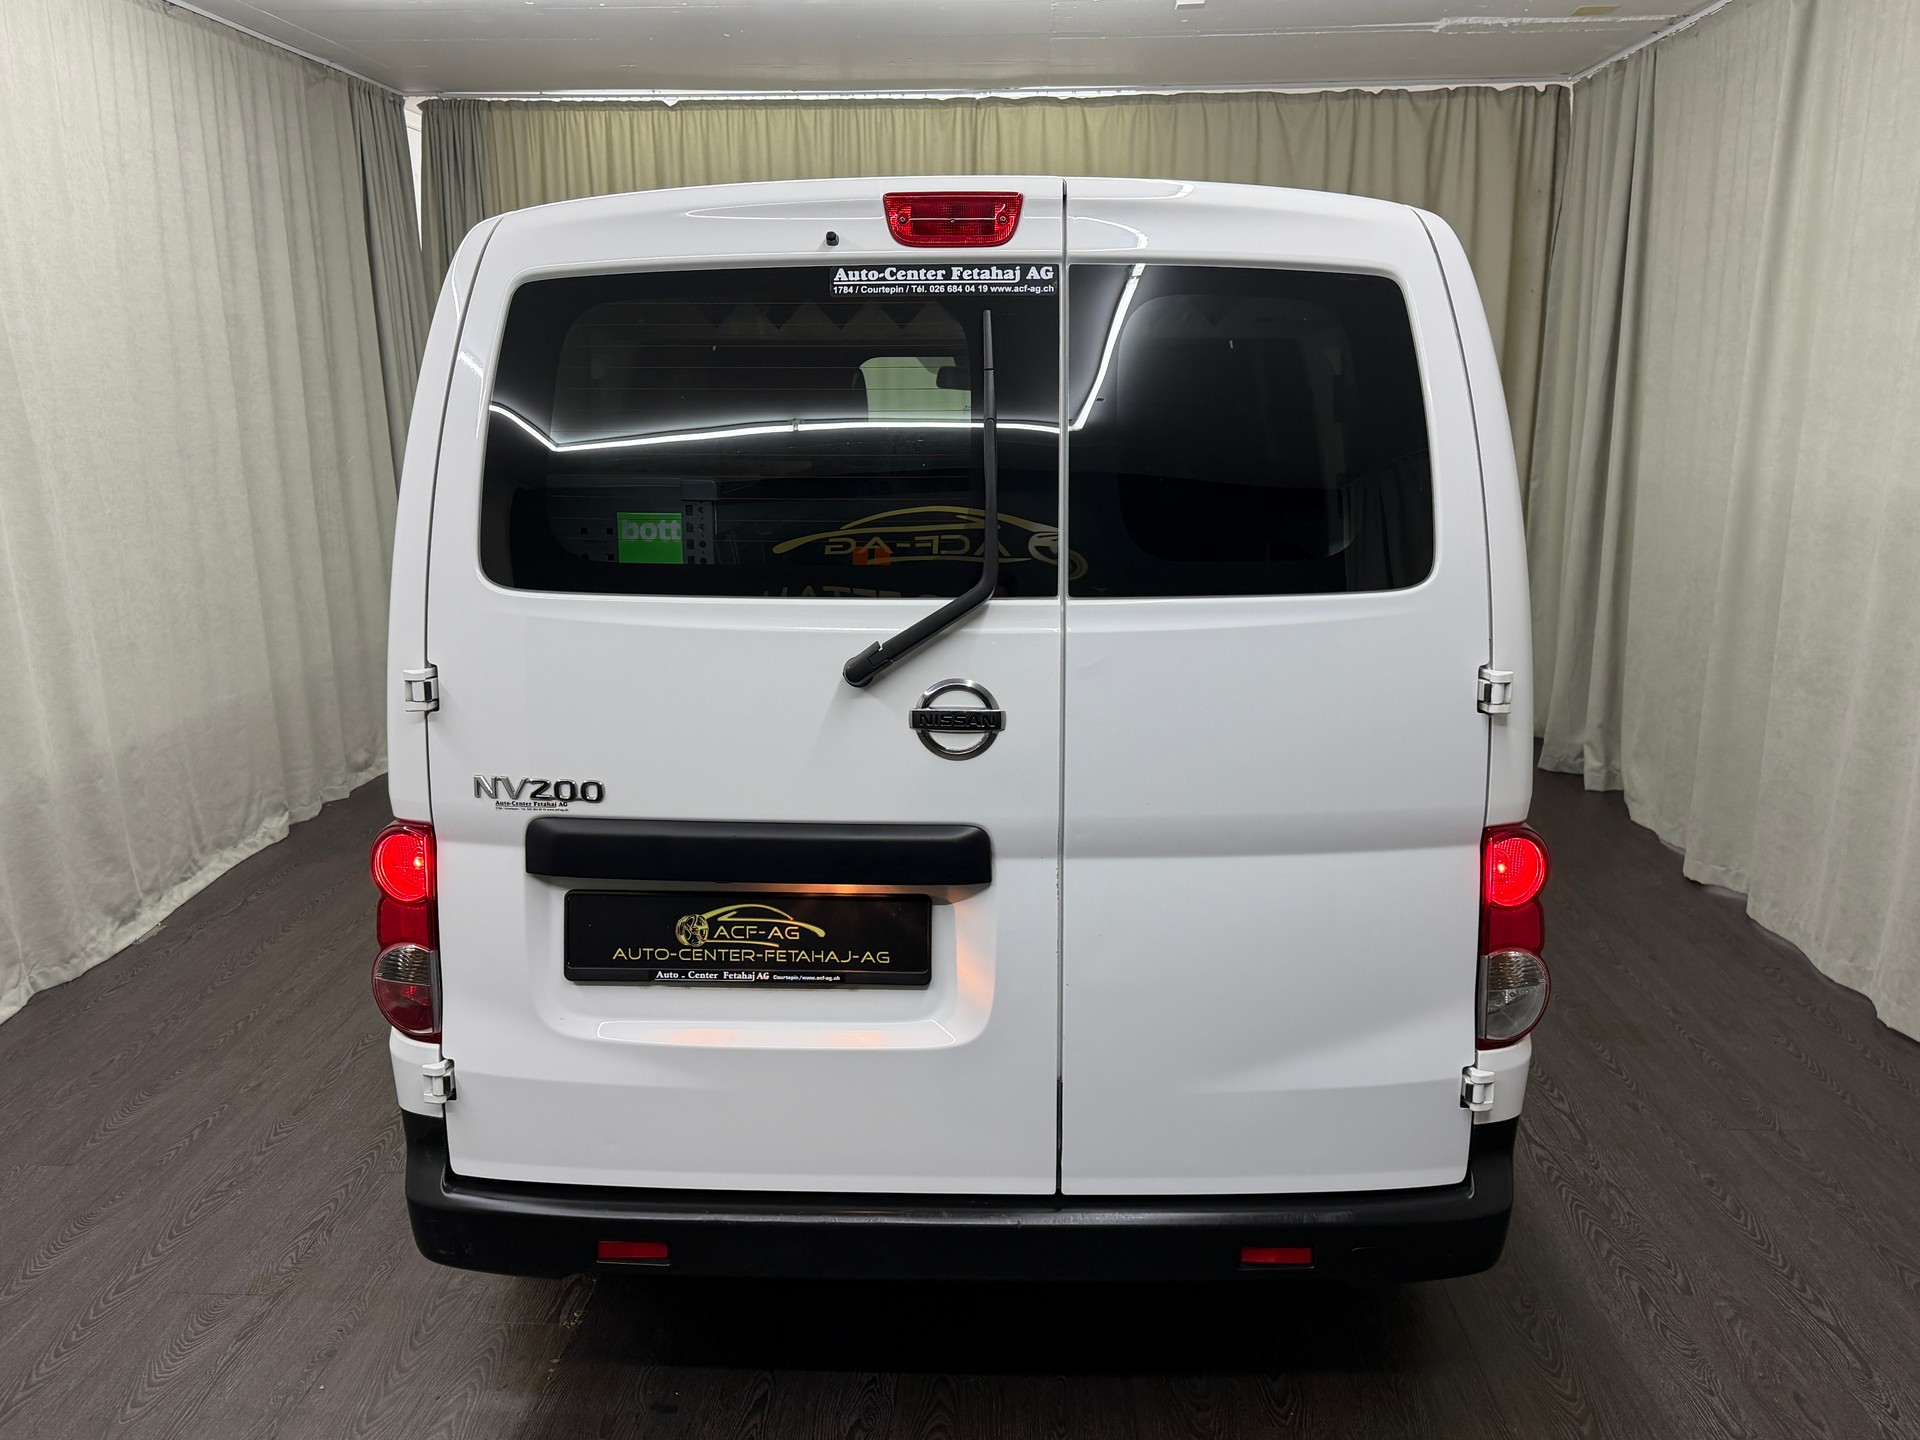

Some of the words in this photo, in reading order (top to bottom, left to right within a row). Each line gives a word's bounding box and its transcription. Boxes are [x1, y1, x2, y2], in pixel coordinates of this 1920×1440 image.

[833, 267, 946, 281] Auto-Center
[951, 266, 1021, 283] Fetahaj
[1026, 266, 1054, 280] AG
[833, 286, 853, 294] 1784
[860, 285, 904, 295] Courtepin
[911, 284, 927, 293] Tél.
[929, 285, 945, 293] 026
[947, 285, 963, 293] 684
[964, 285, 976, 293] 04
[977, 285, 989, 293] 19
[990, 285, 1055, 294] www.acf-ag.ch
[621, 519, 682, 542] bott
[919, 714, 996, 728] NISSAN
[473, 775, 605, 803] NV200
[713, 925, 800, 940] ACF-AG
[612, 947, 891, 964] AUTO-CENTER-FETAHAJ-AG
[656, 970, 679, 979] Auto
[688, 971, 719, 979] Center
[723, 971, 755, 981] Fetahaj
[756, 972, 770, 980] AG
